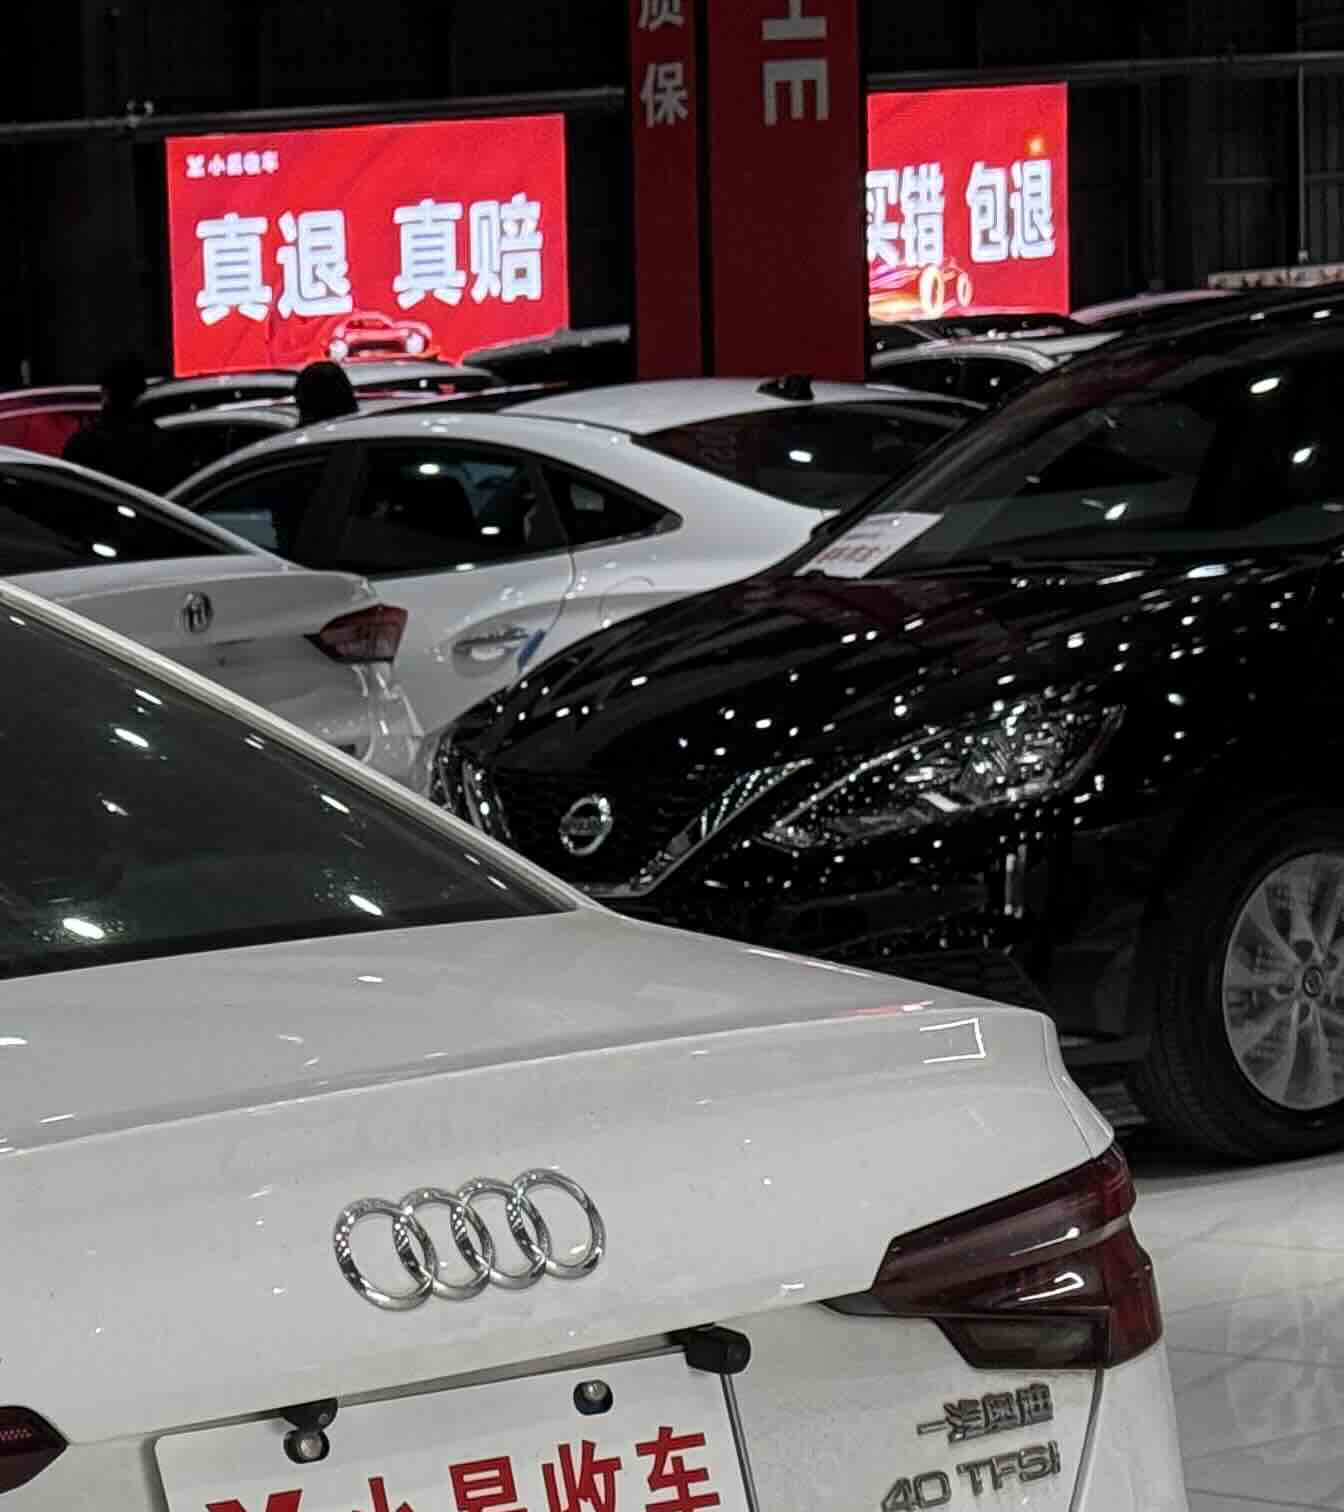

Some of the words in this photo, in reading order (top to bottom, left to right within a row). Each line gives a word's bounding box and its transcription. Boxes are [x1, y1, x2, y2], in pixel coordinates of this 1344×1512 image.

[194, 209, 354, 325] 真退
[392, 192, 544, 310] 真赔
[866, 162, 946, 267] 买错
[965, 158, 1056, 263] 包退
[955, 1438, 1062, 1498] TFSI
